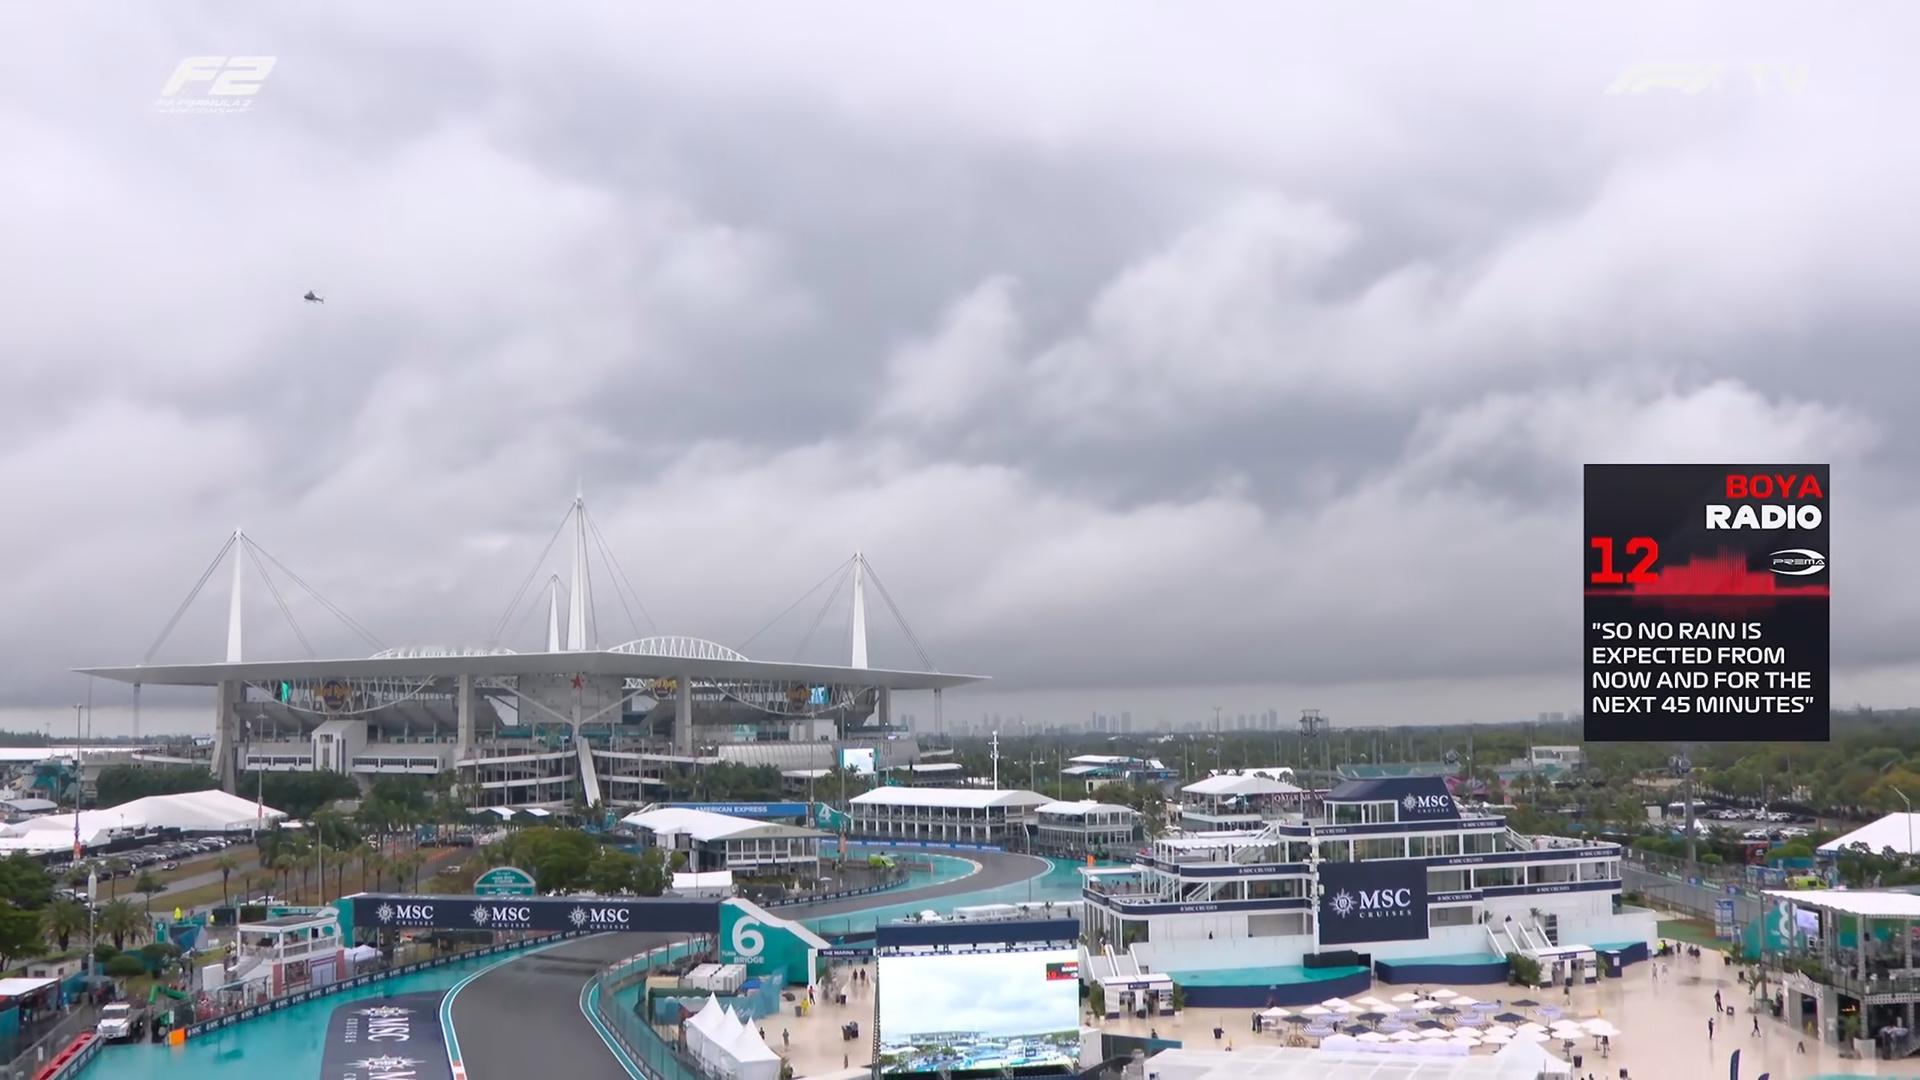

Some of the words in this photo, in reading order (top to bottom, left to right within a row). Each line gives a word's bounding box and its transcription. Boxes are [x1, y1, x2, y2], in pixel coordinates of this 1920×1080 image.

[1418, 795, 1449, 808] MSC
[818, 805, 832, 820] 4
[1359, 888, 1411, 909] MSC
[396, 905, 434, 919] MSC
[492, 907, 531, 921] MSC
[590, 908, 630, 923] MSC
[1359, 910, 1412, 919] CRUISES
[732, 915, 765, 957] 6
[734, 956, 764, 964] BRIDGE
[368, 1017, 410, 1042] MSC
